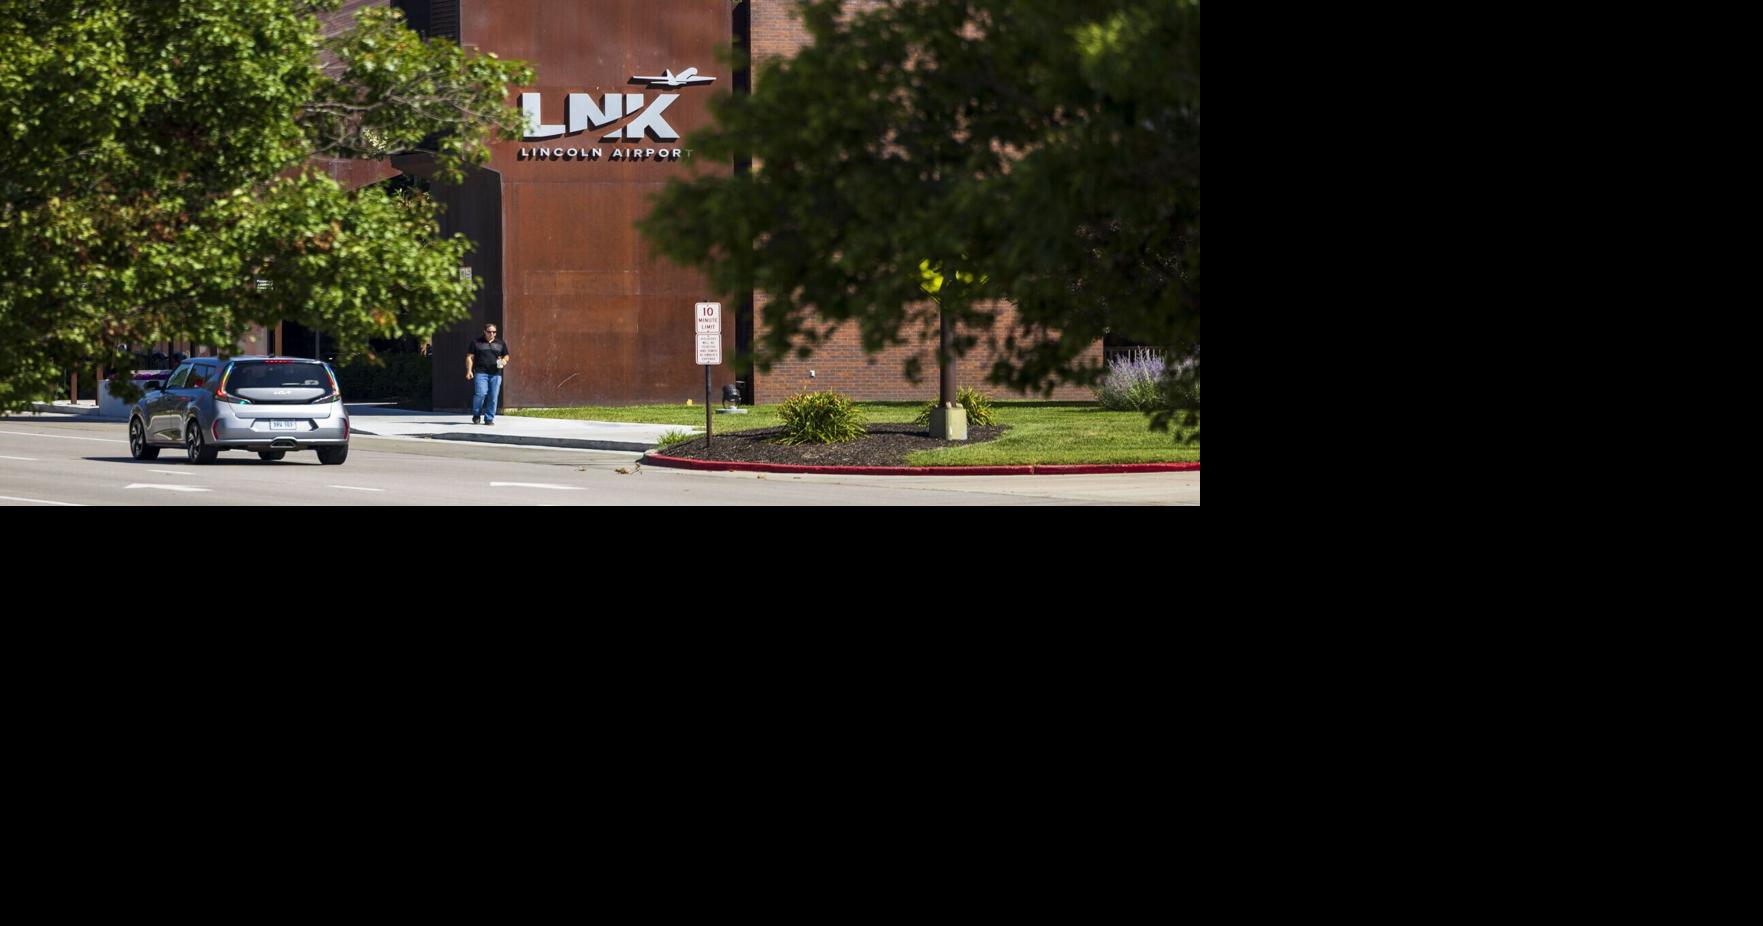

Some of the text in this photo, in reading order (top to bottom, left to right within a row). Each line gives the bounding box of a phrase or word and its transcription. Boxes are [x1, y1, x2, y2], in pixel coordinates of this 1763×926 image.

[522, 93, 681, 138] LNK
[521, 147, 693, 158] LINCOLN AIRPORT
[703, 307, 714, 317] 10
